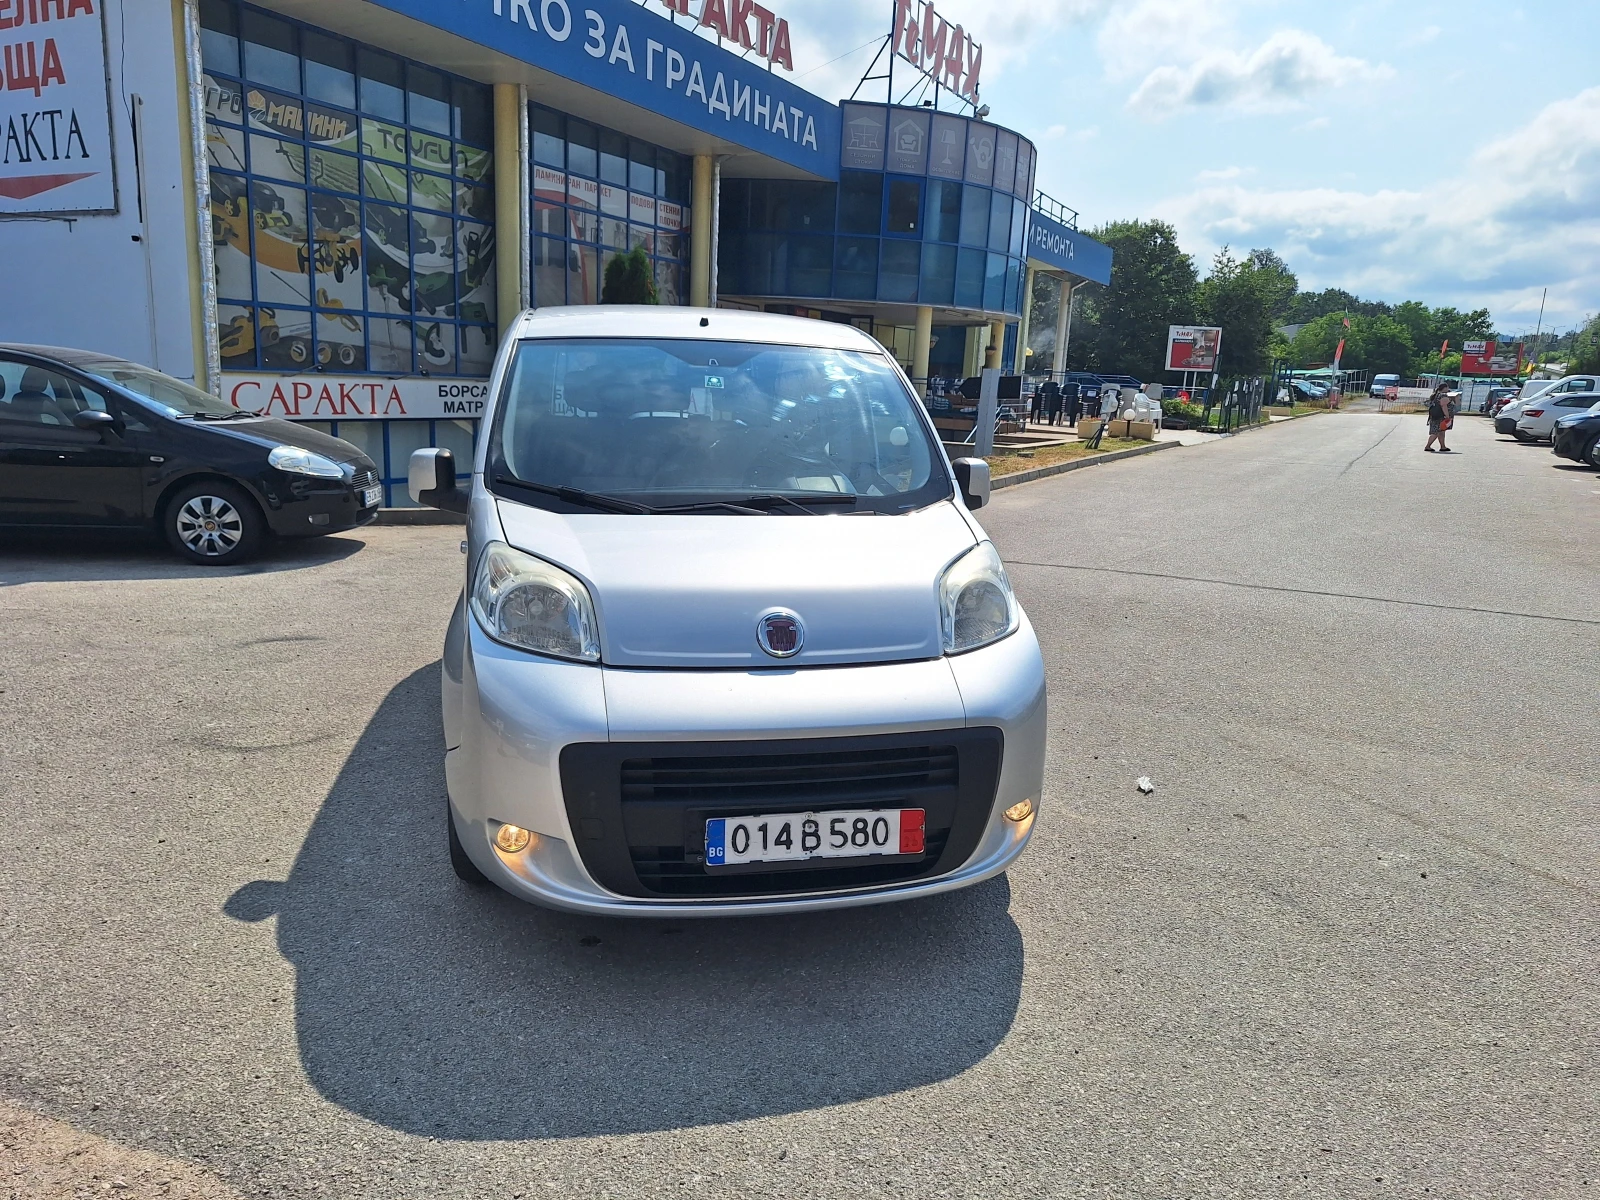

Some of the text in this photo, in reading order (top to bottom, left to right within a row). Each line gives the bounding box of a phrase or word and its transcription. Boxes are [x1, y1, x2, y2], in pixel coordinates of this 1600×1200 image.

[660, 0, 793, 71] АКТА
[0, 38, 66, 97] ЩА
[583, 9, 636, 74] ЗА
[646, 38, 818, 151] ГРАДИНАТА
[0, 107, 90, 164] АКТА
[1036, 226, 1074, 260] РЕМОНТА
[231, 381, 407, 416] САРАКТА
[708, 846, 724, 858] BG
